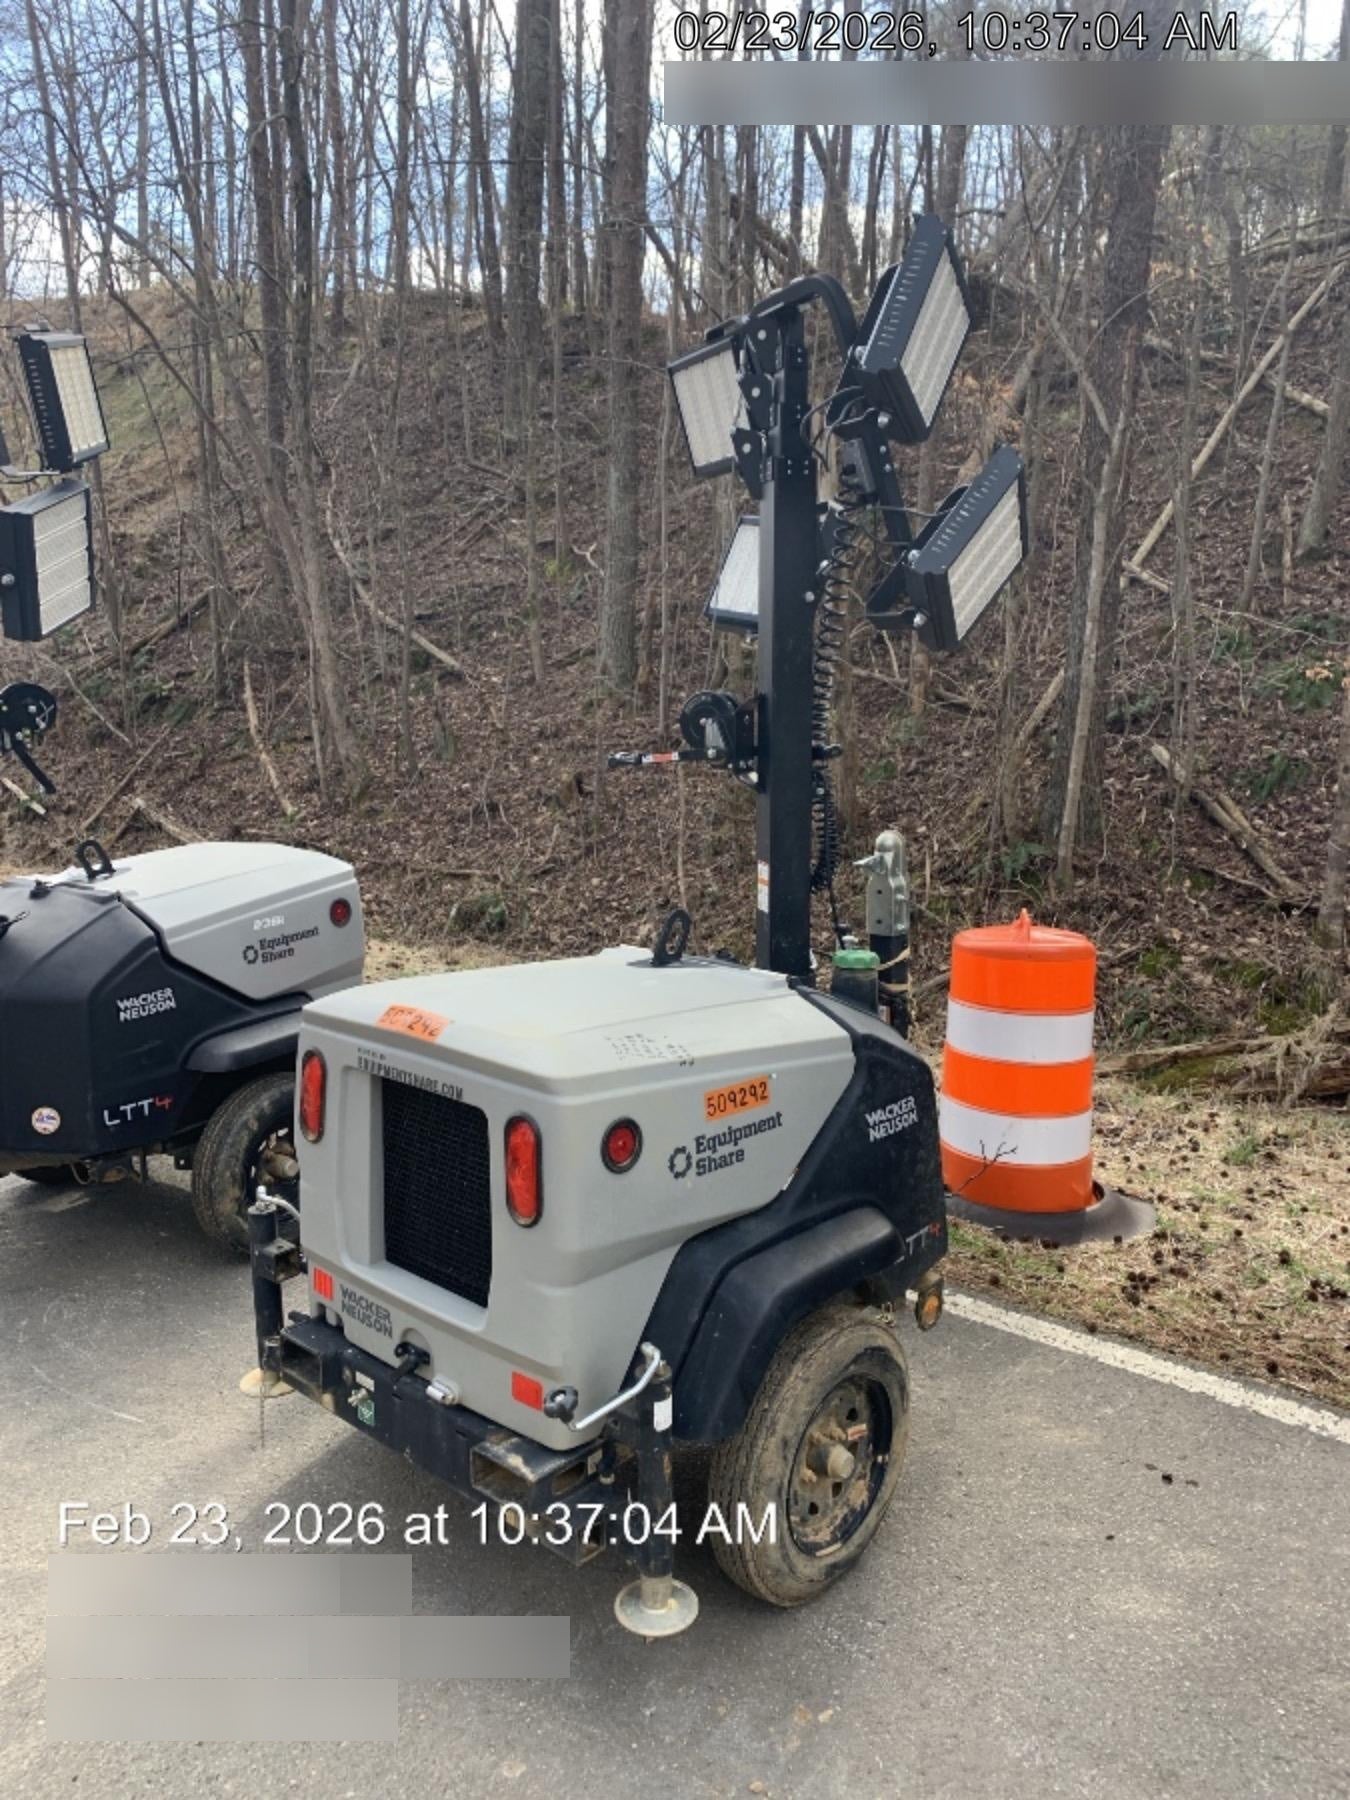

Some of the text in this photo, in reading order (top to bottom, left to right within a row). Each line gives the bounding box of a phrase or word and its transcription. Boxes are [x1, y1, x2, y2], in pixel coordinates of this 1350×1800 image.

[116, 987, 174, 1011] WACKER
[119, 997, 176, 1022] NEUSON
[103, 1096, 173, 1126] LTT4
[706, 1081, 769, 1117] 509292
[864, 1095, 917, 1126] WACKER
[694, 1111, 783, 1154] Equipment
[868, 1109, 919, 1142] NEUSON
[695, 1149, 745, 1177] Share
[341, 1300, 393, 1338] NEUSON
